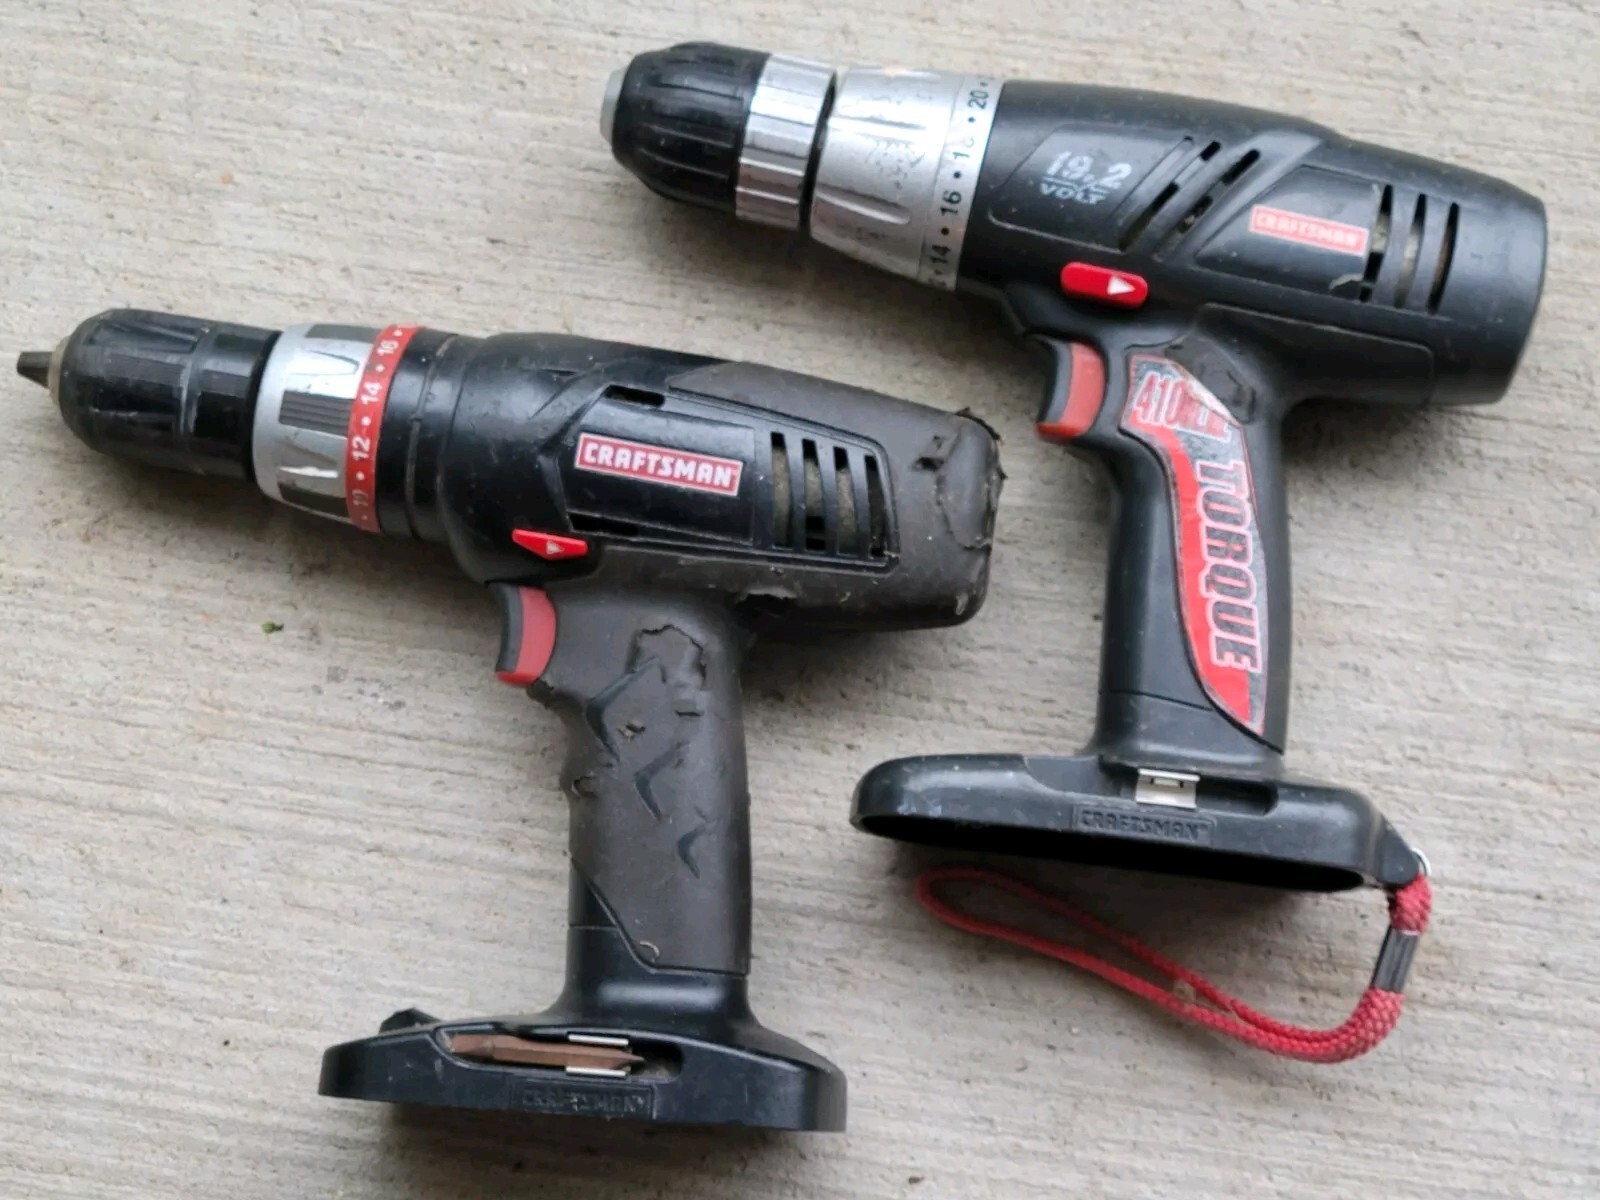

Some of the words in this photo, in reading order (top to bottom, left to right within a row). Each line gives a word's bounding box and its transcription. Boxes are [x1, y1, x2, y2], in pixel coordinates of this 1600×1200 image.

[967, 89, 989, 110] 20
[1046, 150, 1132, 189] 19.2
[940, 190, 963, 216] 16
[930, 244, 951, 265] 14
[376, 339, 400, 357] 16
[361, 382, 384, 405] 14
[1131, 370, 1189, 430] 410
[352, 435, 371, 461] 12
[583, 441, 733, 488] CRAFTSMAN
[1196, 459, 1263, 674] TORQUE
[1081, 808, 1202, 842] CRAFTSMAN
